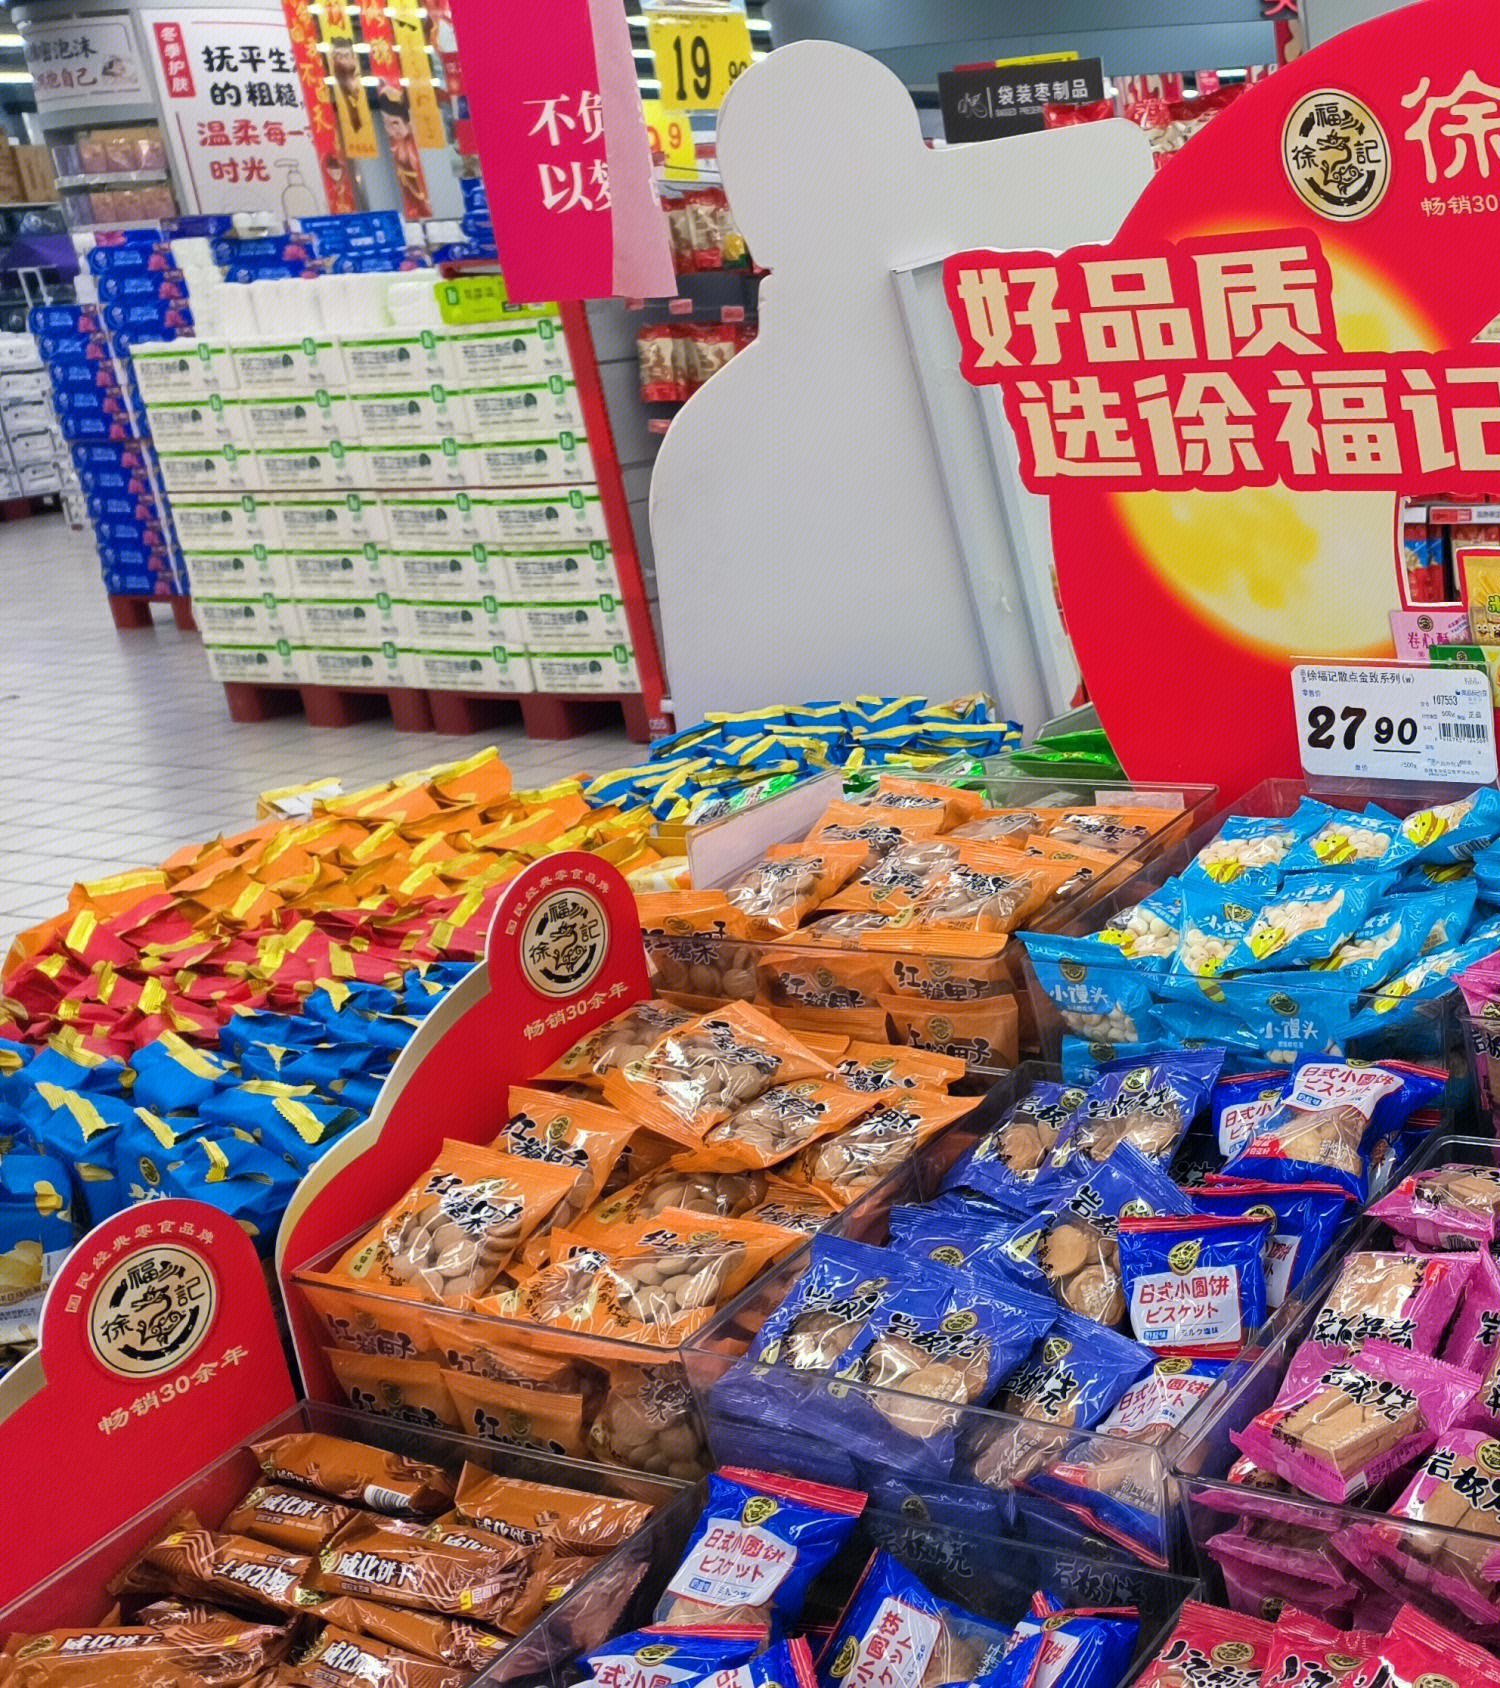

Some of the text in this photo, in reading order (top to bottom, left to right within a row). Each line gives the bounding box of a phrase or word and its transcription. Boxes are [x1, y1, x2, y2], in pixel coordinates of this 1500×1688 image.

[158, 26, 190, 94] 冬季护肤
[673, 35, 712, 101] 19
[998, 78, 1089, 106] 袋装枣制品
[208, 157, 271, 183] 时光
[956, 244, 1329, 369] 好品质
[1306, 705, 1419, 751] 27 90
[522, 981, 629, 1041] 畅销30余年
[1049, 984, 1109, 1006] 小馒头
[1259, 1018, 1320, 1041] 小馒头
[1145, 1306, 1219, 1324] ビスケット
[97, 1343, 249, 1436] 畅销30余年
[698, 1553, 765, 1584] ビスケット
